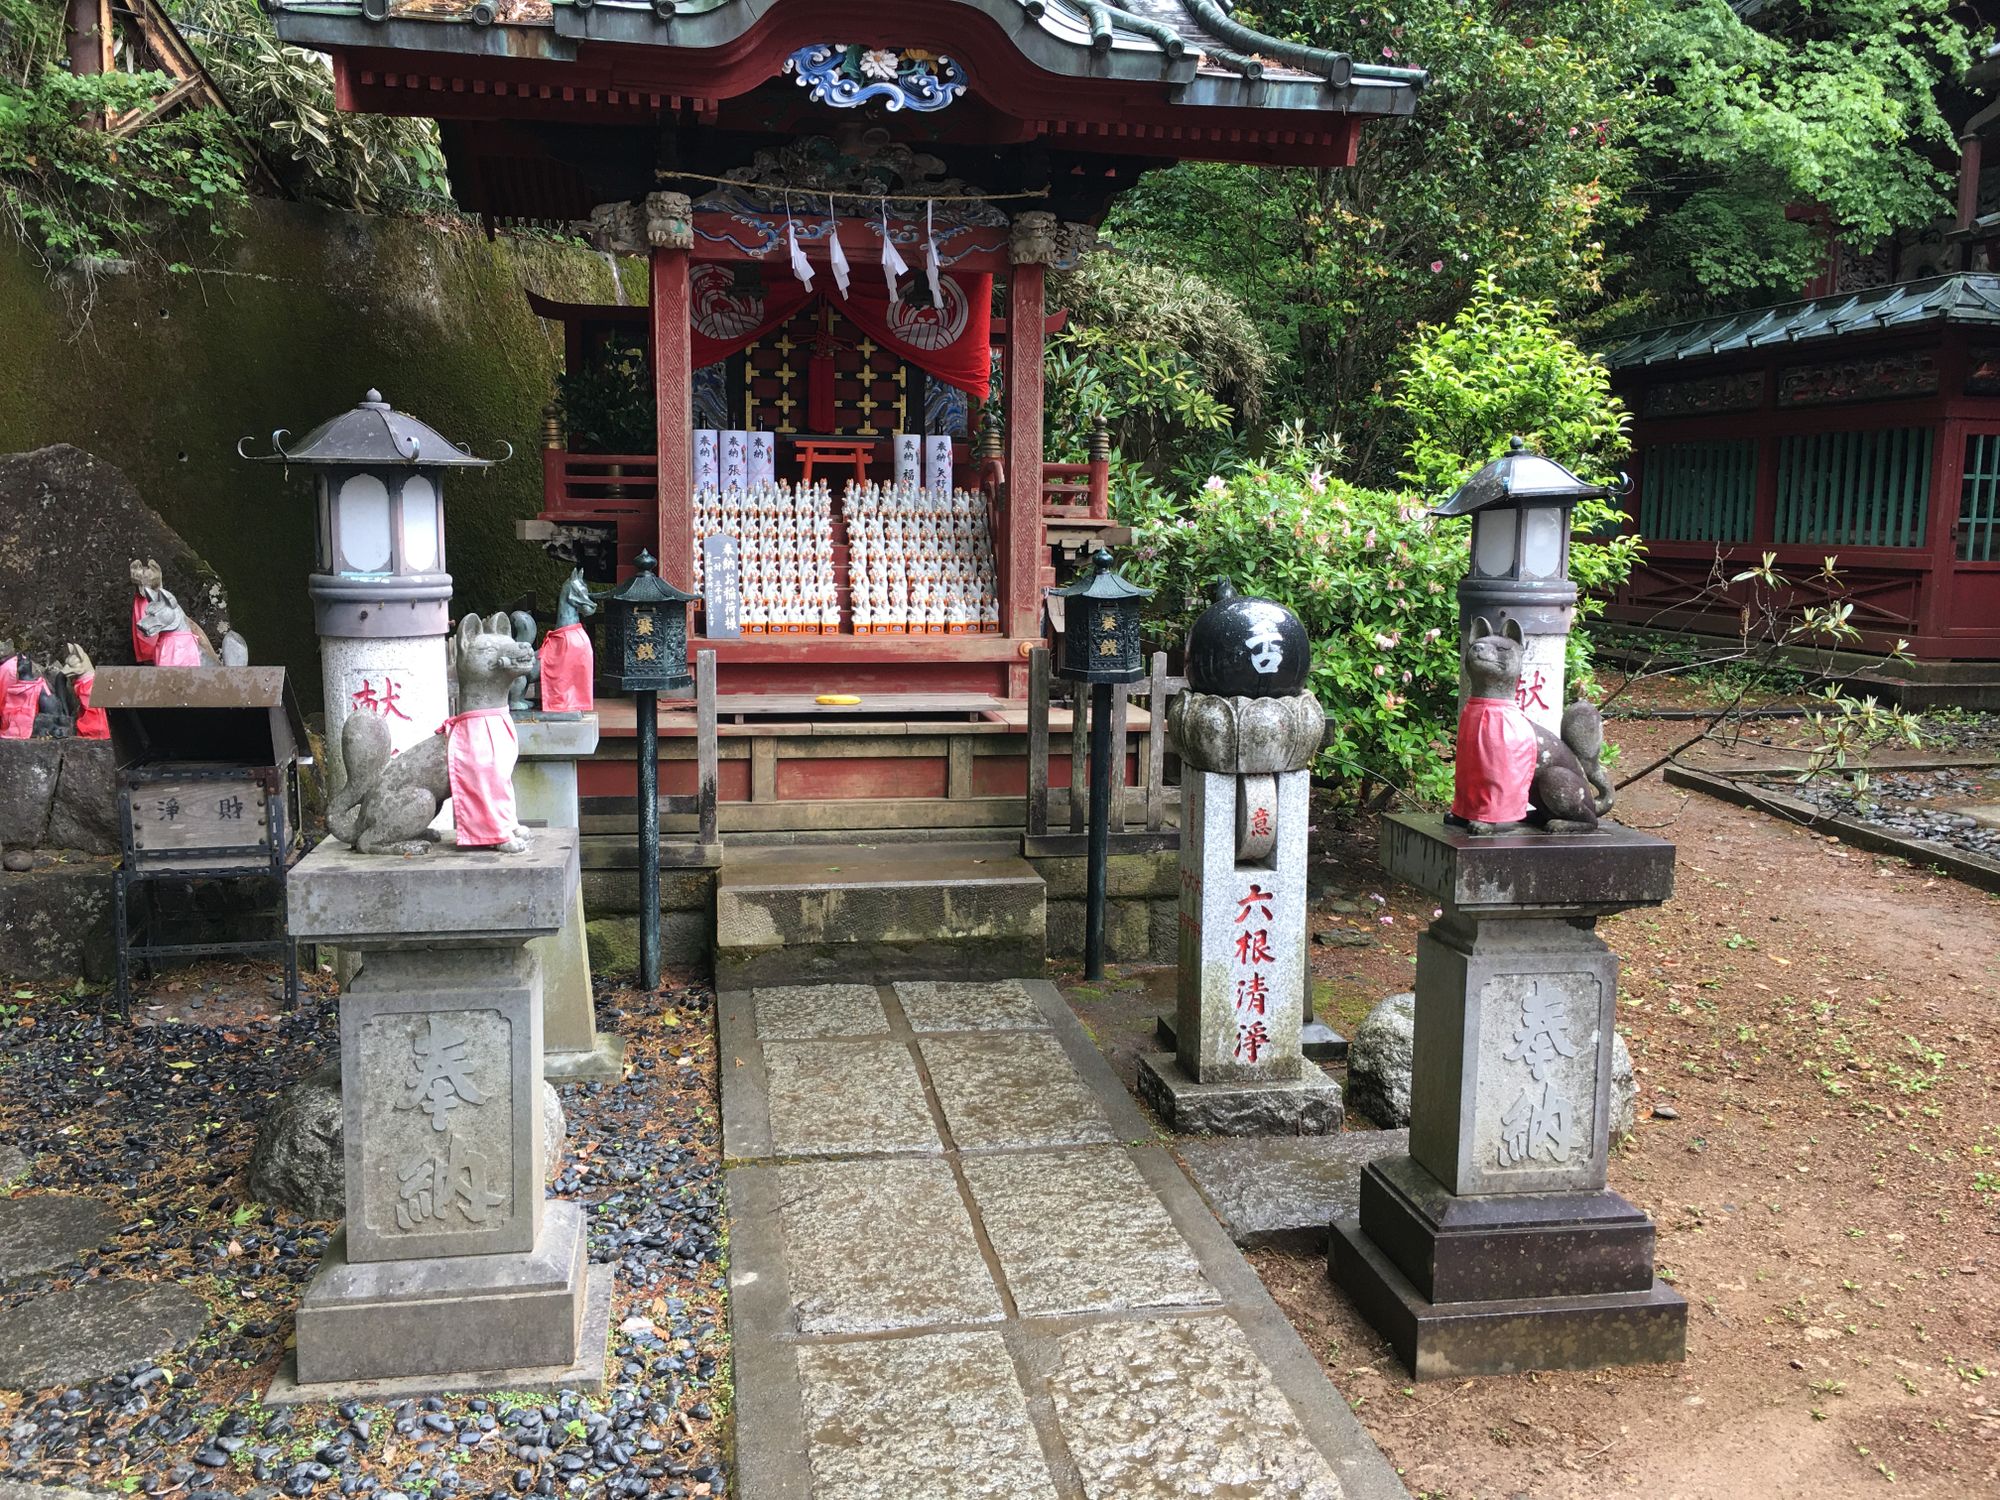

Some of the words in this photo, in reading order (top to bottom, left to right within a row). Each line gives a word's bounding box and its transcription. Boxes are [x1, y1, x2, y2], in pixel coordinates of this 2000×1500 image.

[753, 437, 765, 460] 奉納
[722, 542, 737, 631] 奉納お稲荷様
[1250, 807, 1272, 837] 意
[1497, 980, 1579, 1168] 奉納
[394, 1016, 505, 1230] 奉納
